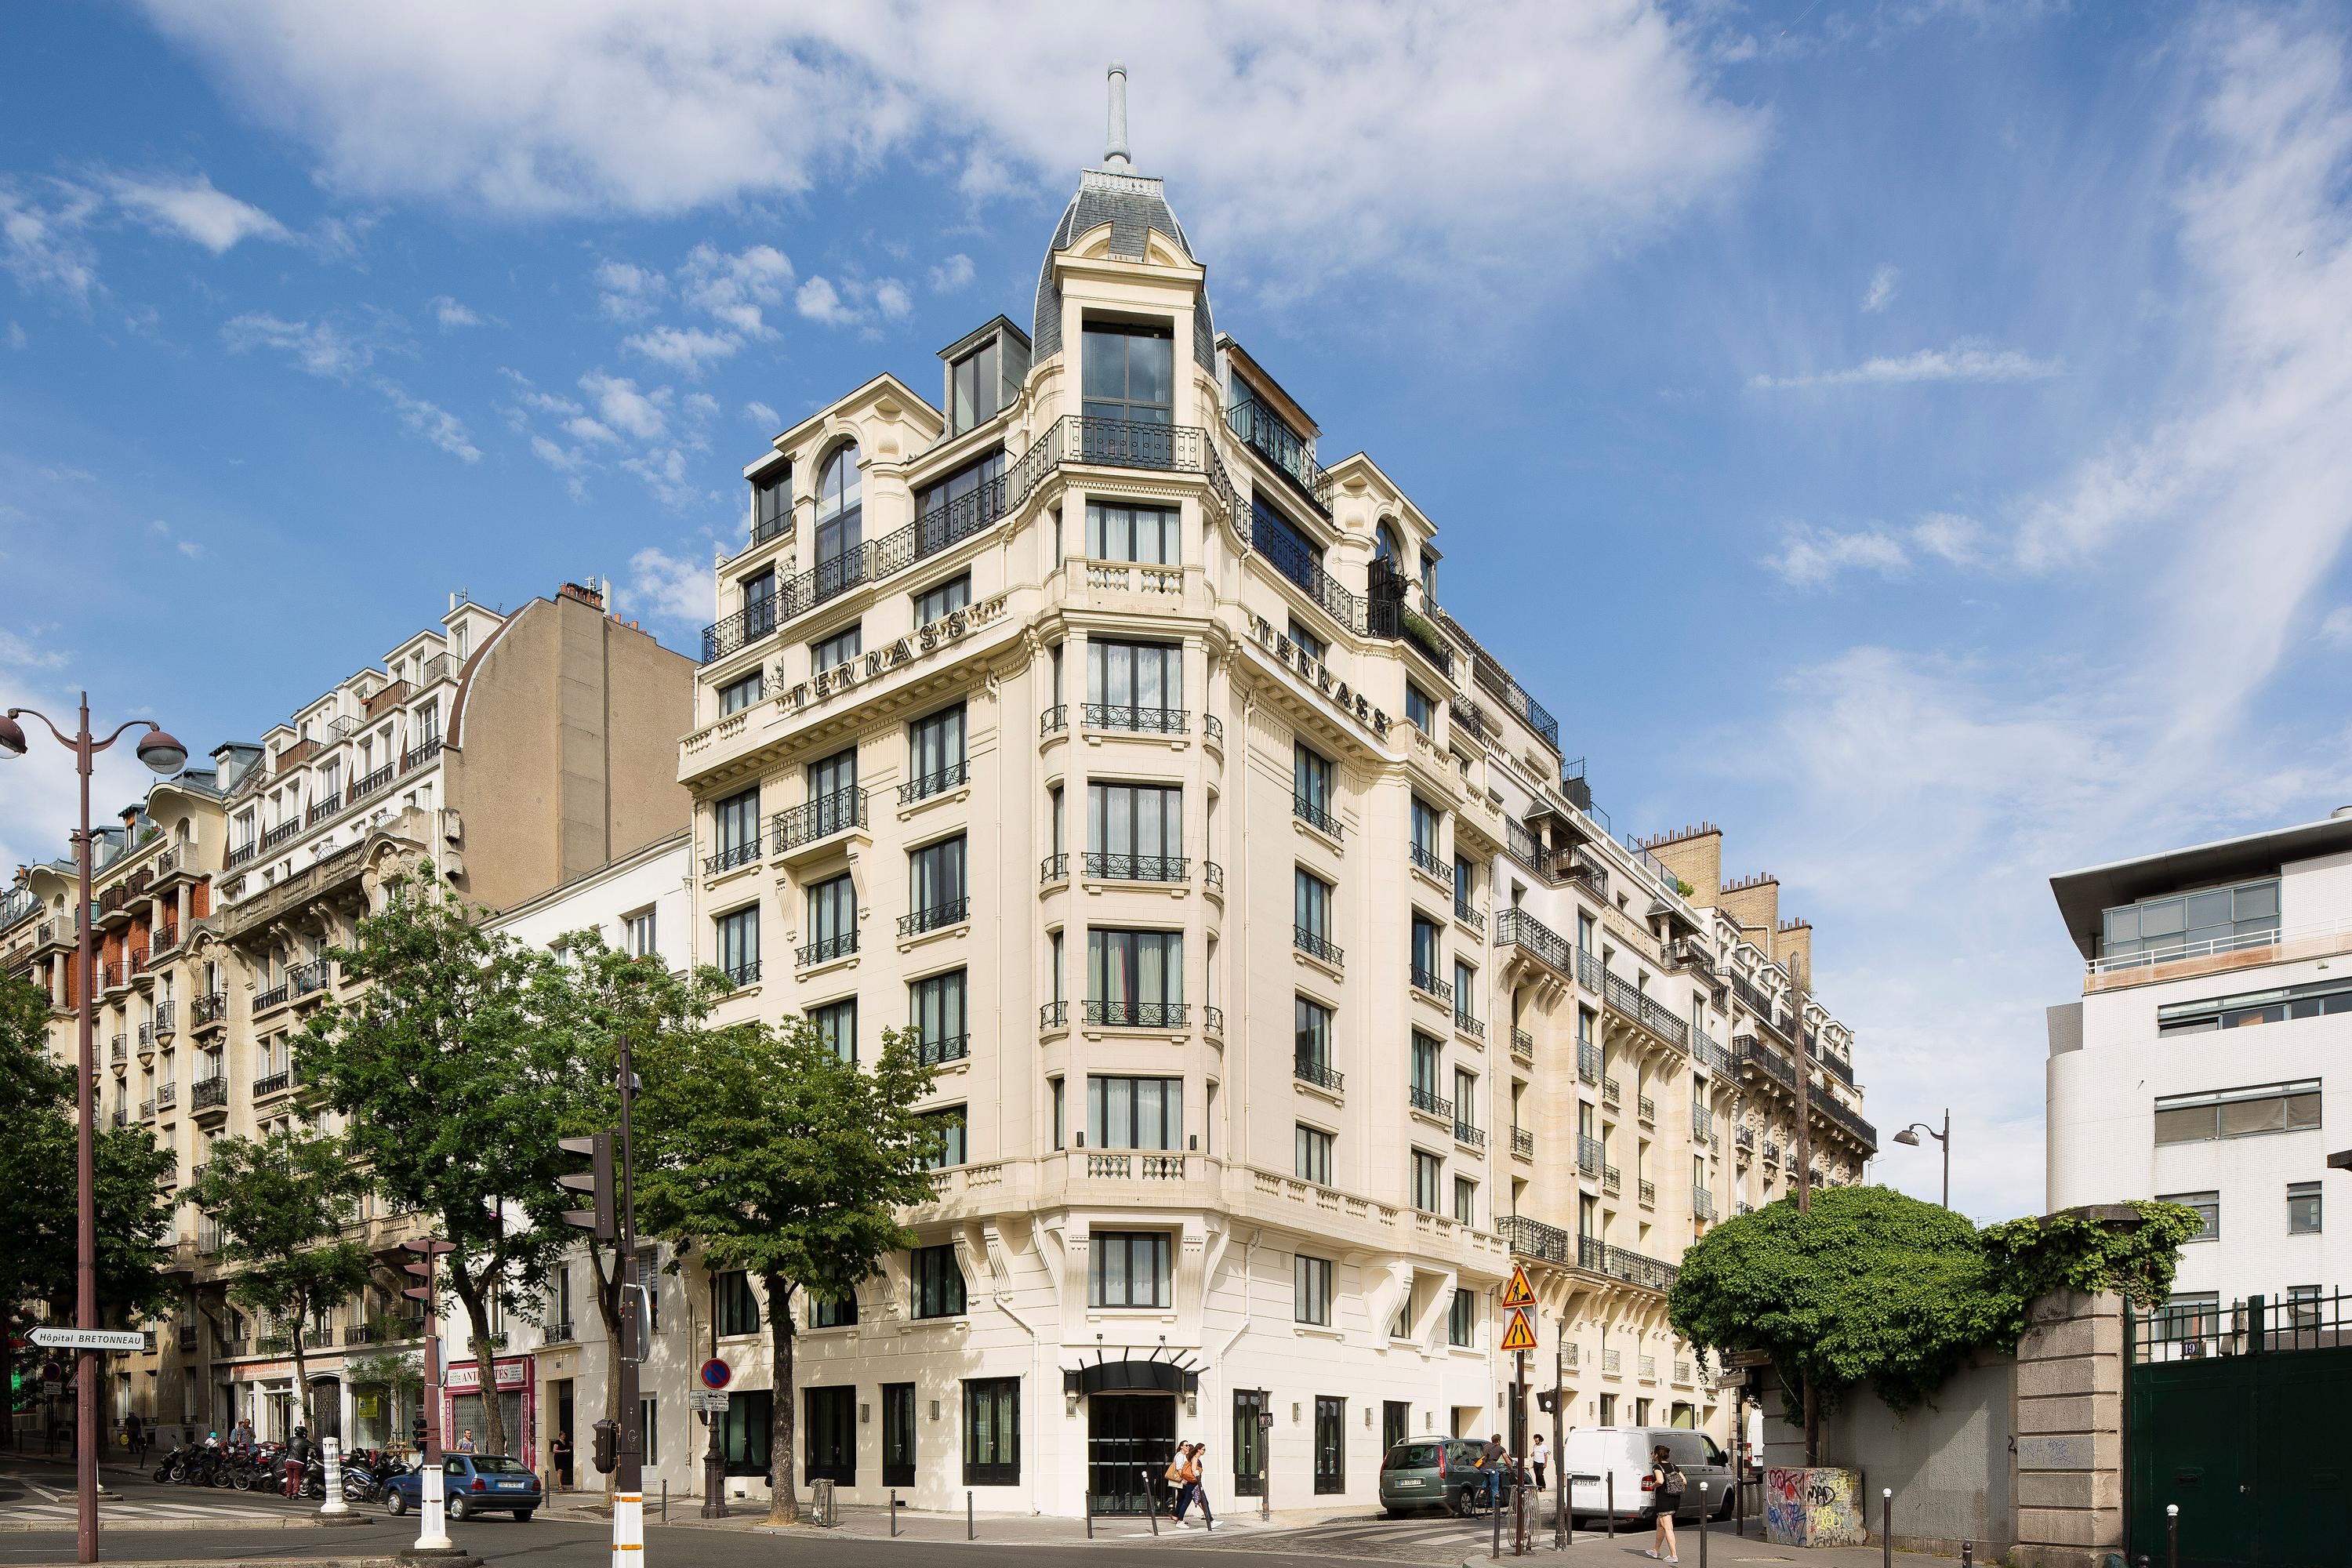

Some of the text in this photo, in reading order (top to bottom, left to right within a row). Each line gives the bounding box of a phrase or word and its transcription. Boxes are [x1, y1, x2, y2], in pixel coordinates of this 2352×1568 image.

[39, 1334, 141, 1345] Hôpital BRETONNEAU
[2185, 1343, 2196, 1355] 19
